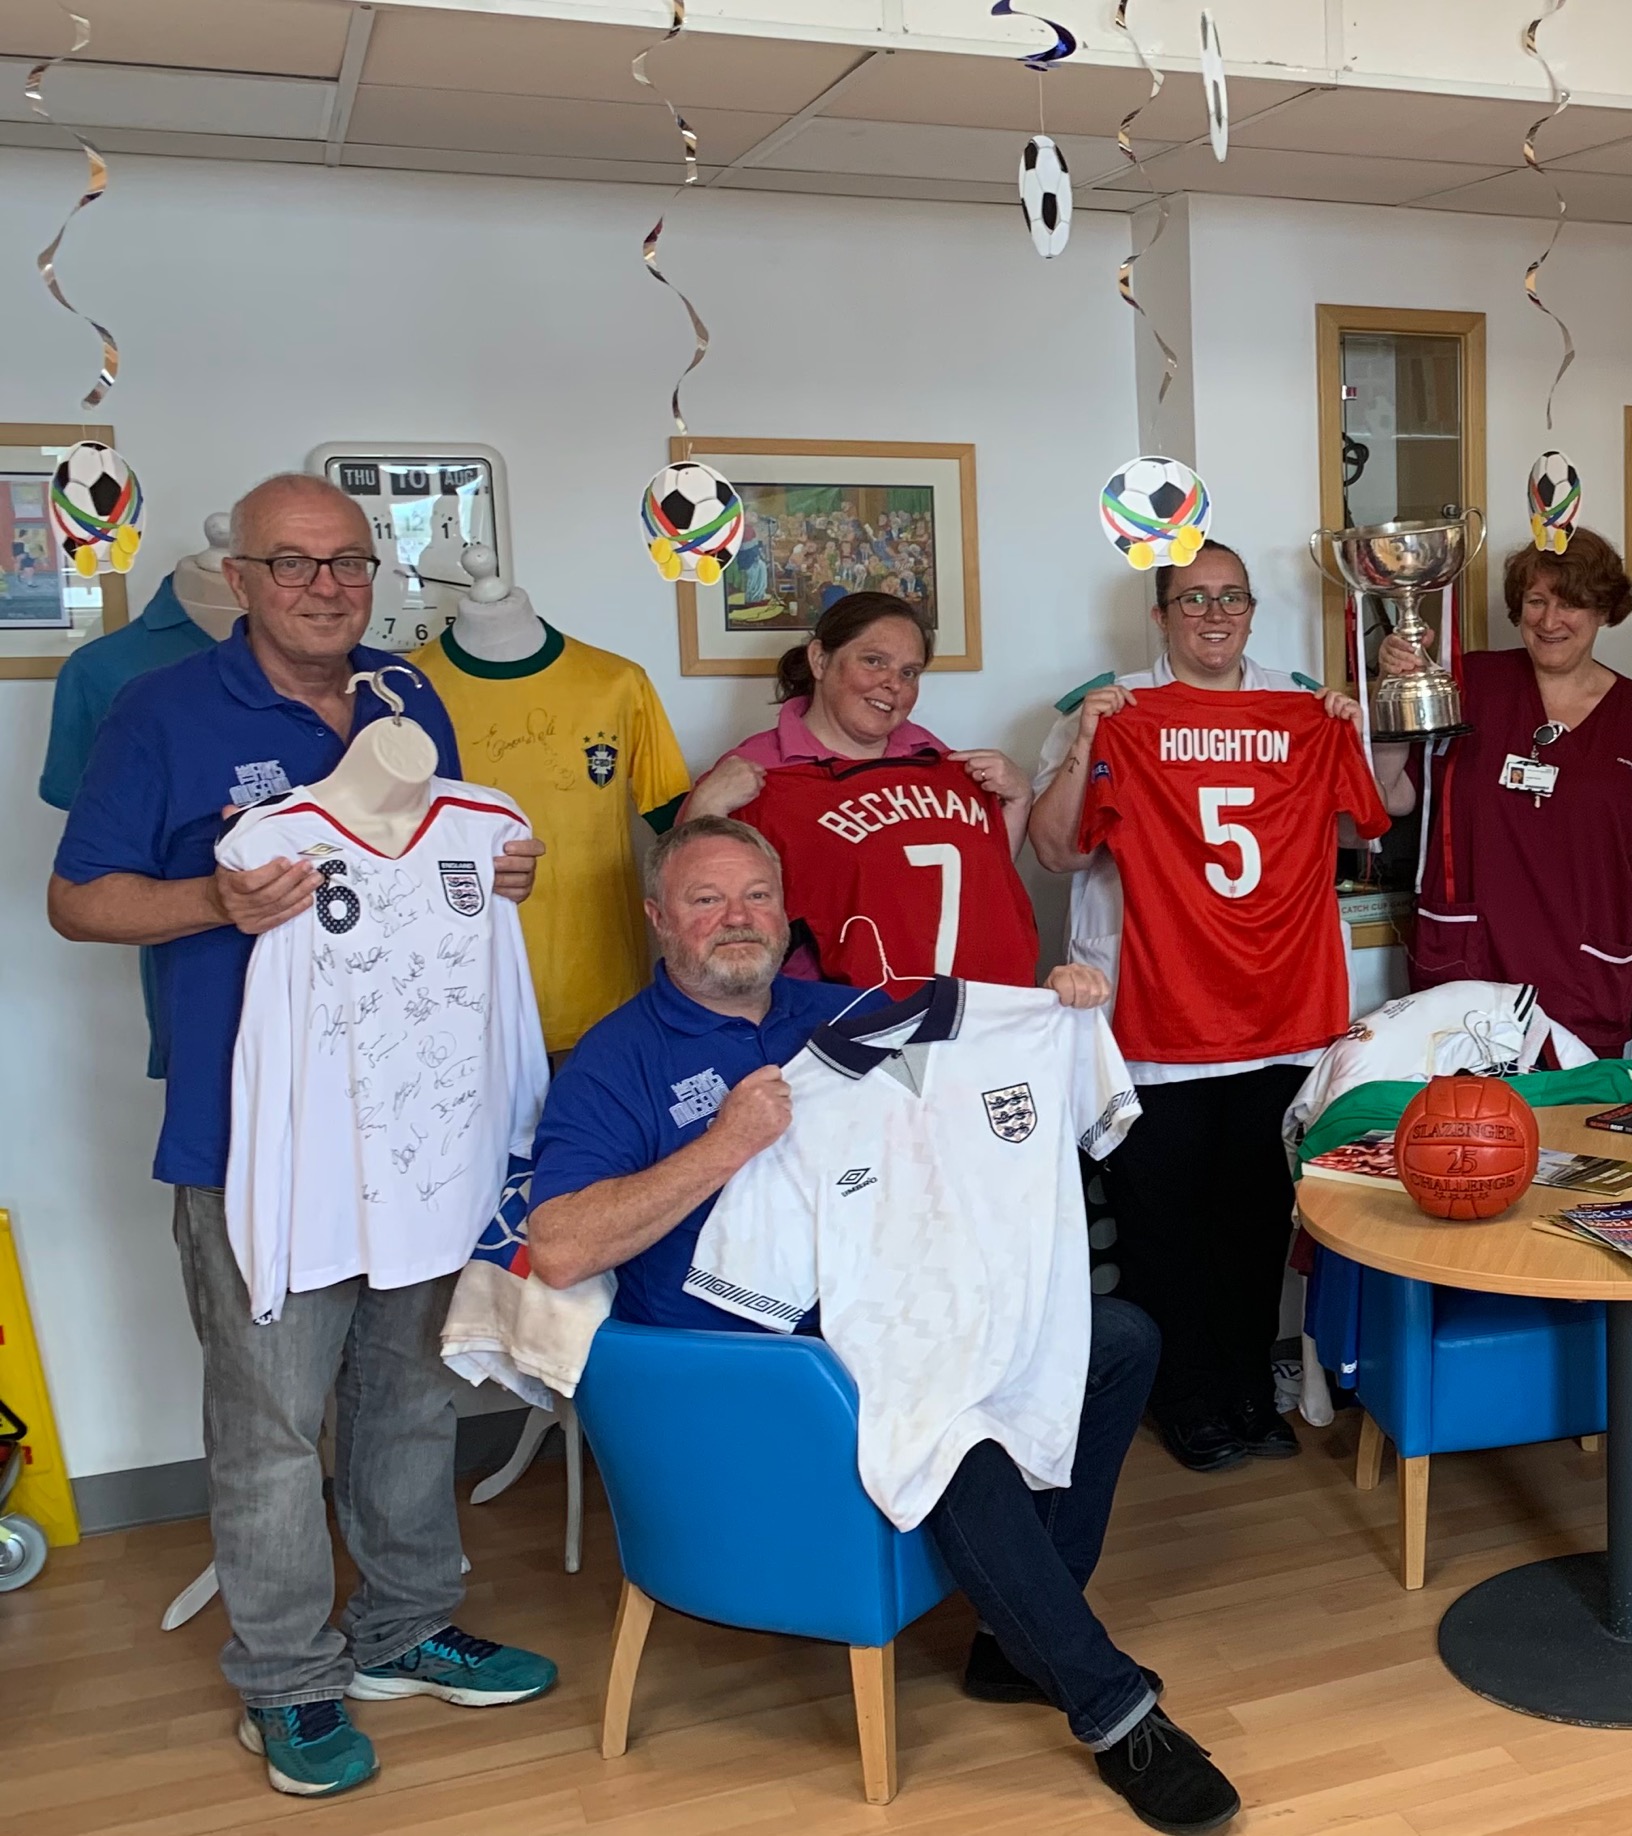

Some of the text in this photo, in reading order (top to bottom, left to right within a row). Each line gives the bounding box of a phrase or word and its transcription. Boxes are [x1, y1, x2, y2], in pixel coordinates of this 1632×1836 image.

[344, 469, 376, 486] THU
[444, 469, 474, 486] AUG
[374, 522, 392, 539] 11
[405, 515, 424, 532] 12
[441, 523, 449, 539] 1
[384, 618, 395, 634] 7
[415, 624, 428, 641] 6
[1160, 728, 1290, 763] HOUGHTON
[817, 785, 990, 844] BECKHAM
[1198, 787, 1262, 898] 5
[315, 859, 361, 935] 6
[903, 843, 962, 977] 7
[1341, 904, 1369, 914] CATCH
[1412, 1122, 1517, 1143] SLAZENGER
[1610, 1123, 1624, 1132] BEST
[1446, 1148, 1478, 1174] 25
[840, 1177, 878, 1198] UMBRO
[1409, 1172, 1516, 1194] CHALLENGE
